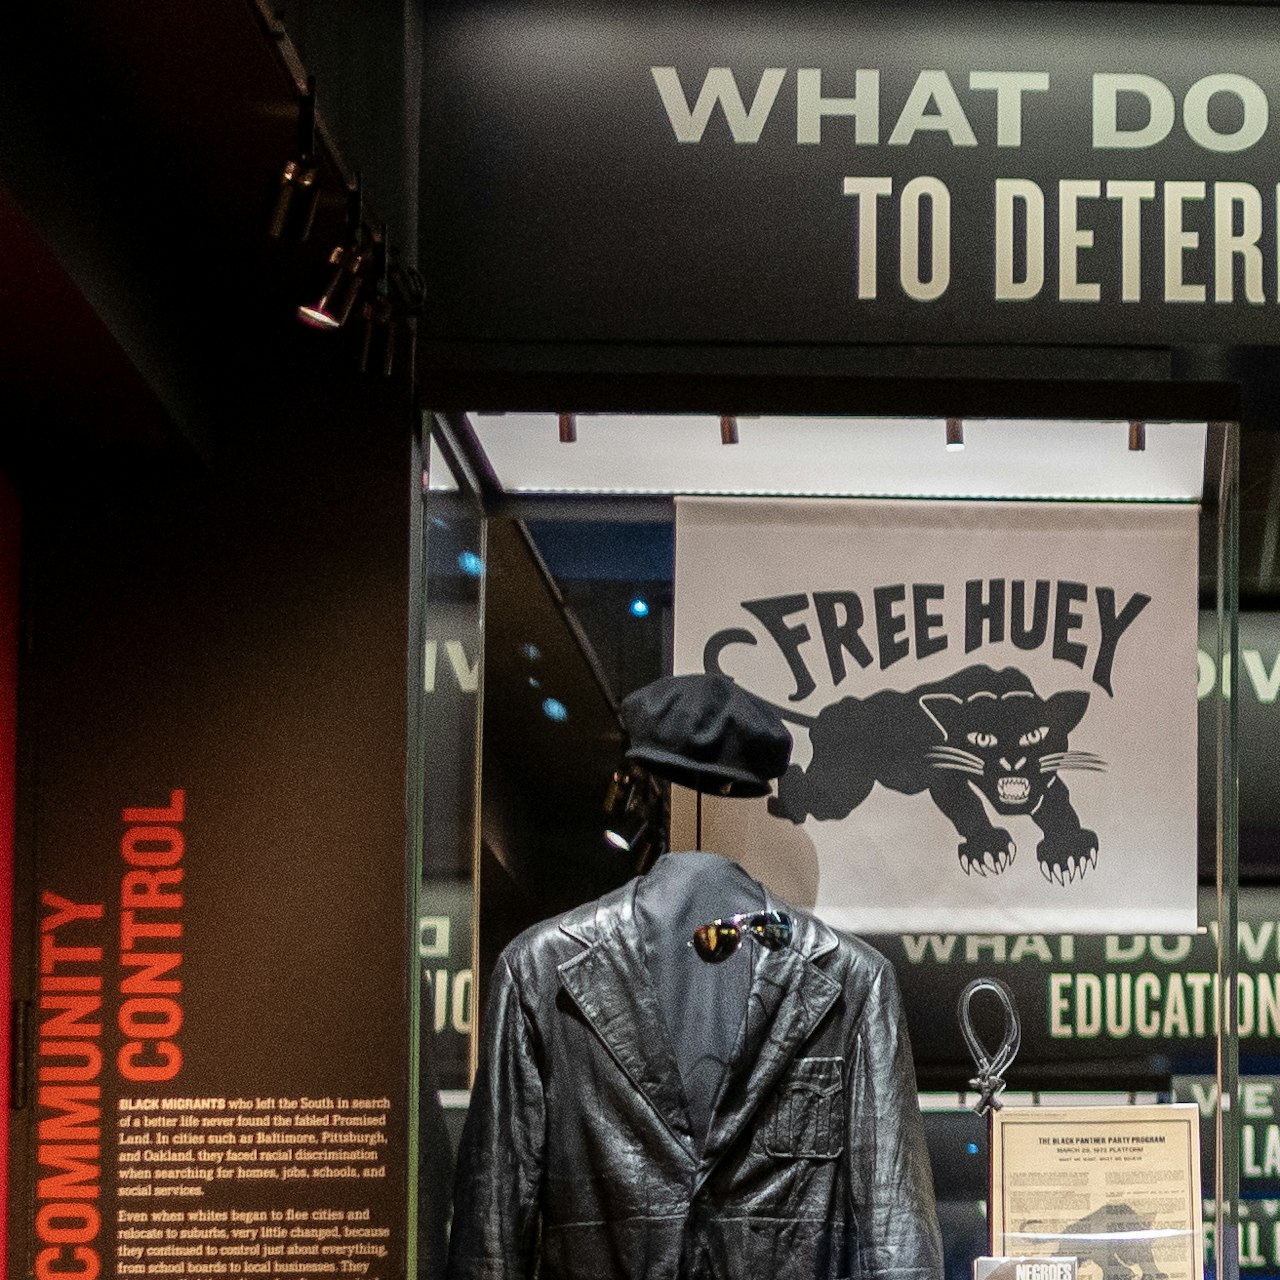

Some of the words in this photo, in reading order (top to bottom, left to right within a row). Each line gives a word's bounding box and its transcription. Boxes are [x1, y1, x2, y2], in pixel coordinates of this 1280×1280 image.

[650, 67, 1049, 147] WHAT
[1092, 71, 1269, 152] DO
[843, 176, 950, 300] TO
[741, 583, 947, 700] FREE
[965, 578, 1152, 698] HUEY
[117, 789, 185, 1082] CONTROL
[902, 934, 1074, 962] WHAT
[1105, 934, 1193, 962] DO
[119, 1098, 159, 1110] BLACK
[161, 1098, 225, 1110] MIGRANTS
[228, 1098, 253, 1110] who
[256, 1098, 275, 1110] left
[279, 1098, 298, 1109] the
[300, 1097, 334, 1109] South
[337, 1098, 349, 1109] in
[352, 1098, 390, 1109] search
[119, 1115, 132, 1127] of
[133, 1118, 142, 1127] a
[144, 1115, 178, 1127] better
[179, 1115, 200, 1127] life
[201, 1117, 235, 1127] never
[236, 1115, 270, 1127] found
[272, 1115, 292, 1127] the
[294, 1115, 329, 1126] fabled
[332, 1115, 386, 1126] Promised
[119, 1133, 153, 1145] Land.
[156, 1132, 169, 1145] In
[172, 1133, 205, 1145] cities
[207, 1132, 236, 1144] such
[239, 1134, 253, 1144] as
[256, 1132, 318, 1145] Baltimore,
[322, 1131, 388, 1147] Pittsburgh,
[1039, 1137, 1051, 1145] THE
[1053, 1137, 1074, 1145] BLACK
[1108, 1136, 1130, 1144] PARTY
[1132, 1136, 1166, 1144] PROGRAM
[1203, 1221, 1266, 1266] FLL
